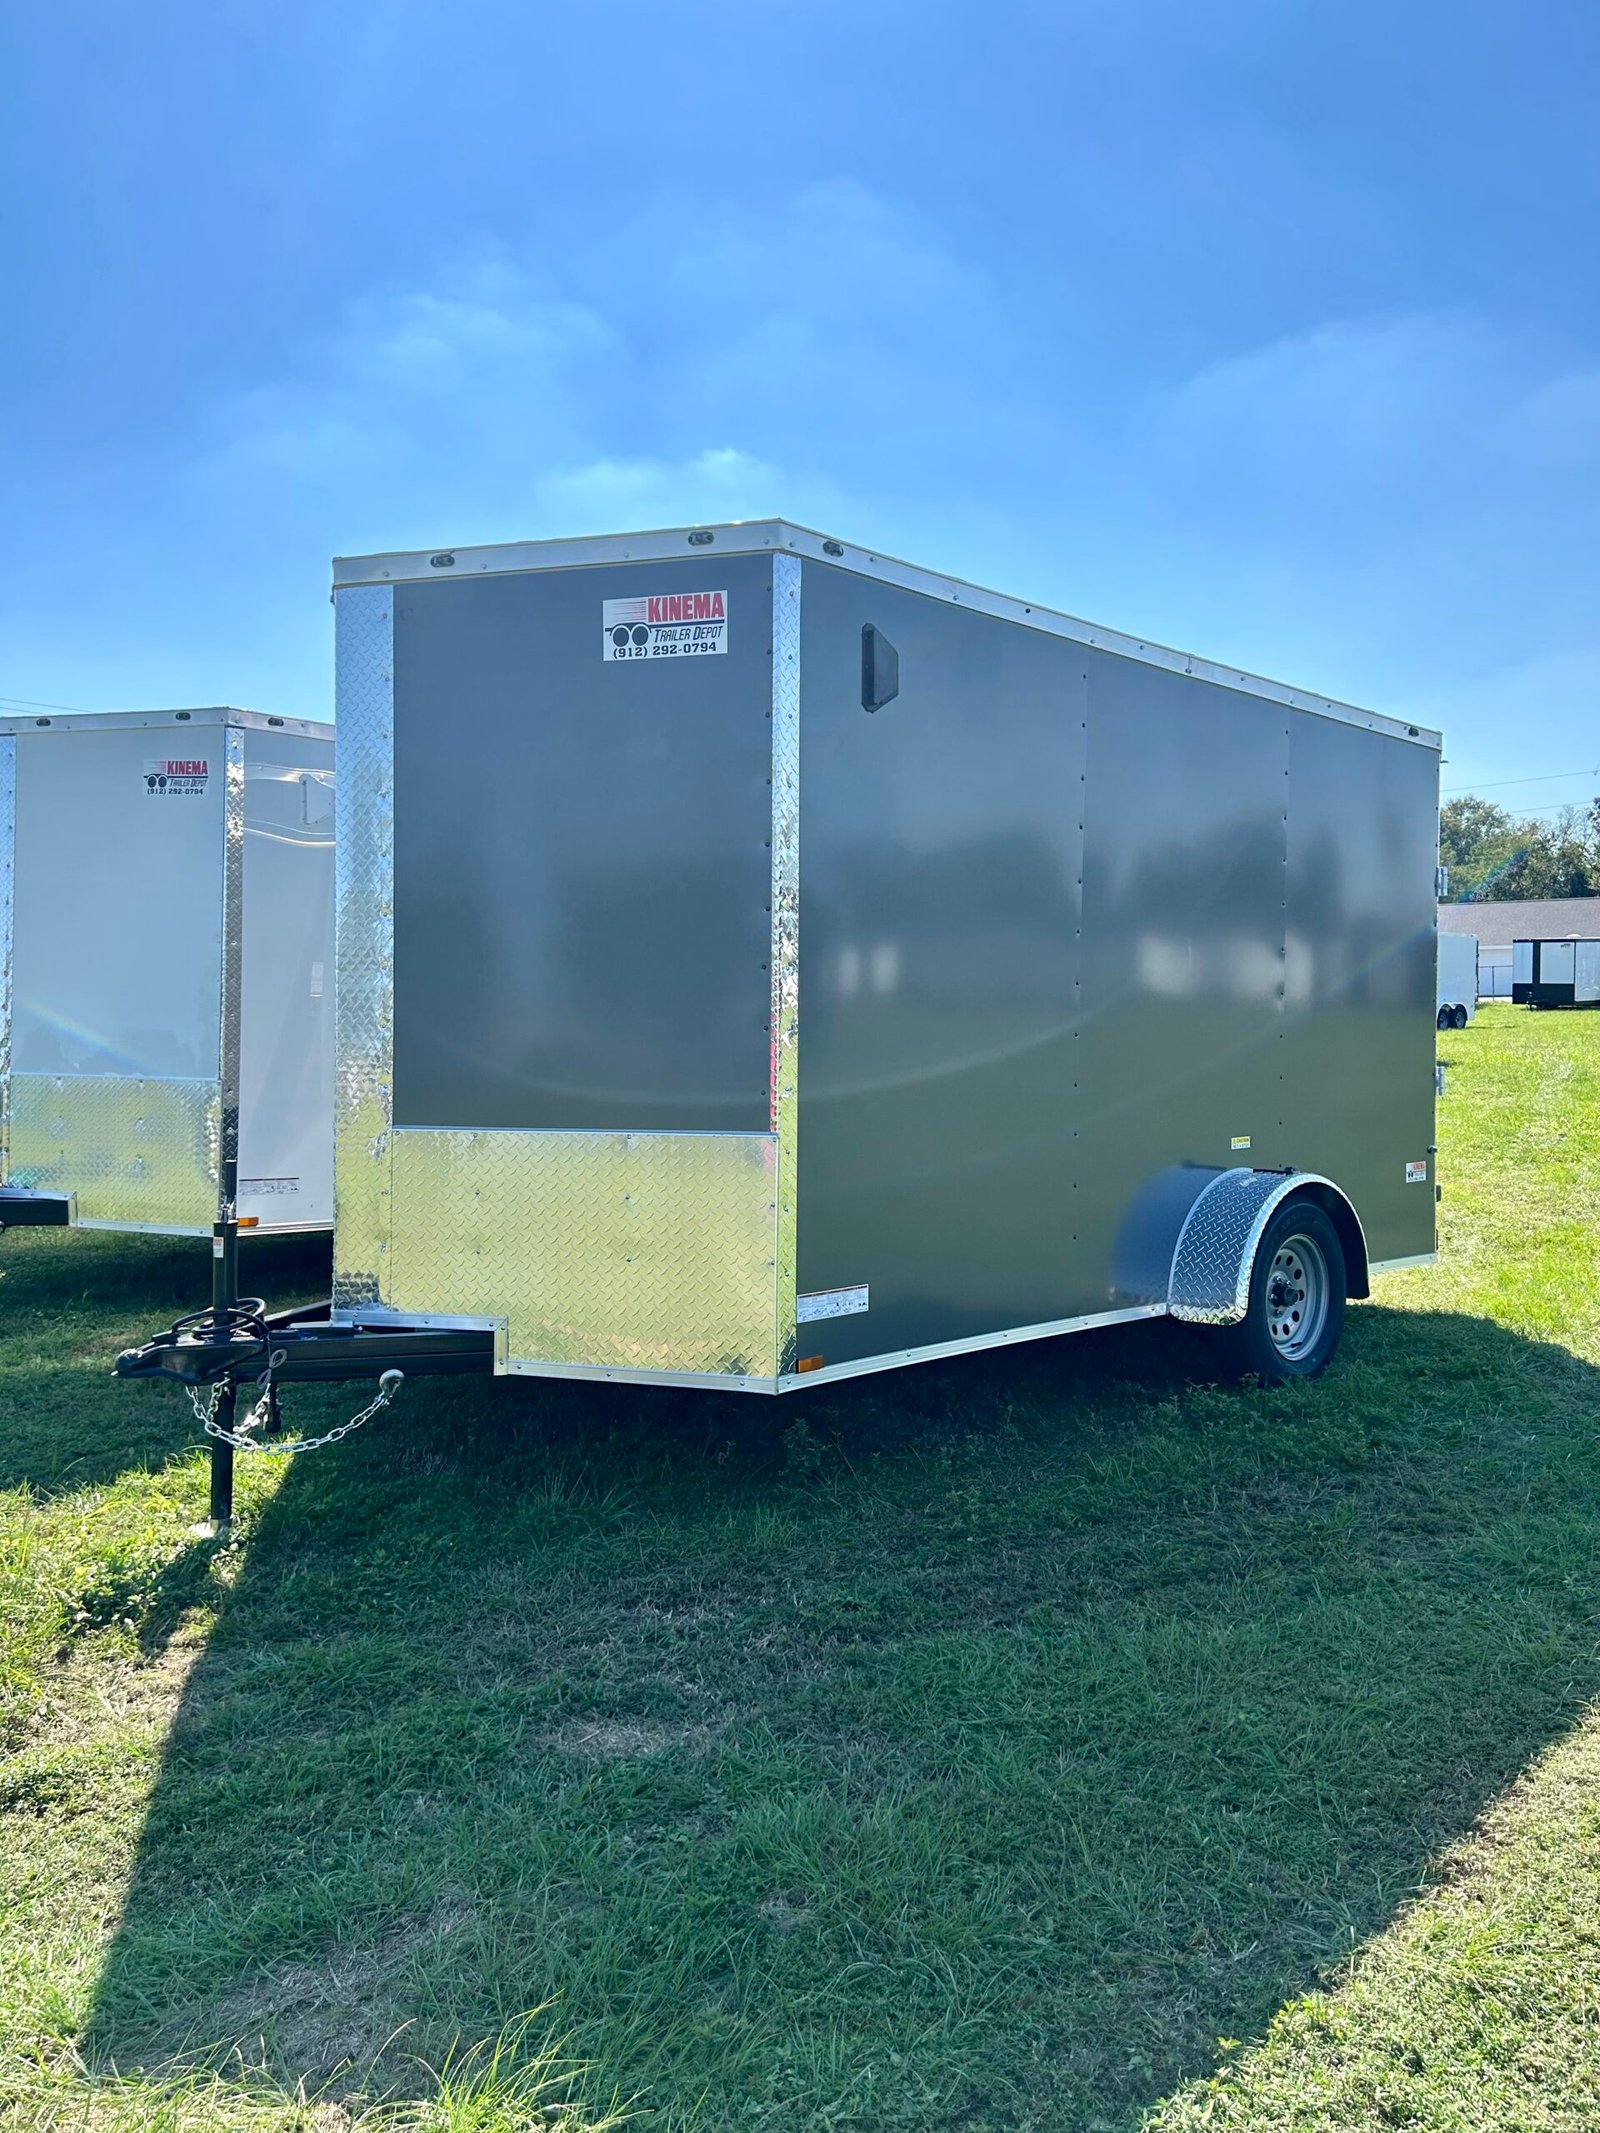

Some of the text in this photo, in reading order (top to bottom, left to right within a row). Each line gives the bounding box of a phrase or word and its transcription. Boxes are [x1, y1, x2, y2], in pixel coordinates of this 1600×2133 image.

[648, 592, 724, 622] KINEMA
[654, 626, 723, 643] TRAILER DEPOT
[613, 642, 717, 659] (912) 292-0794
[167, 760, 208, 775] KINEMA
